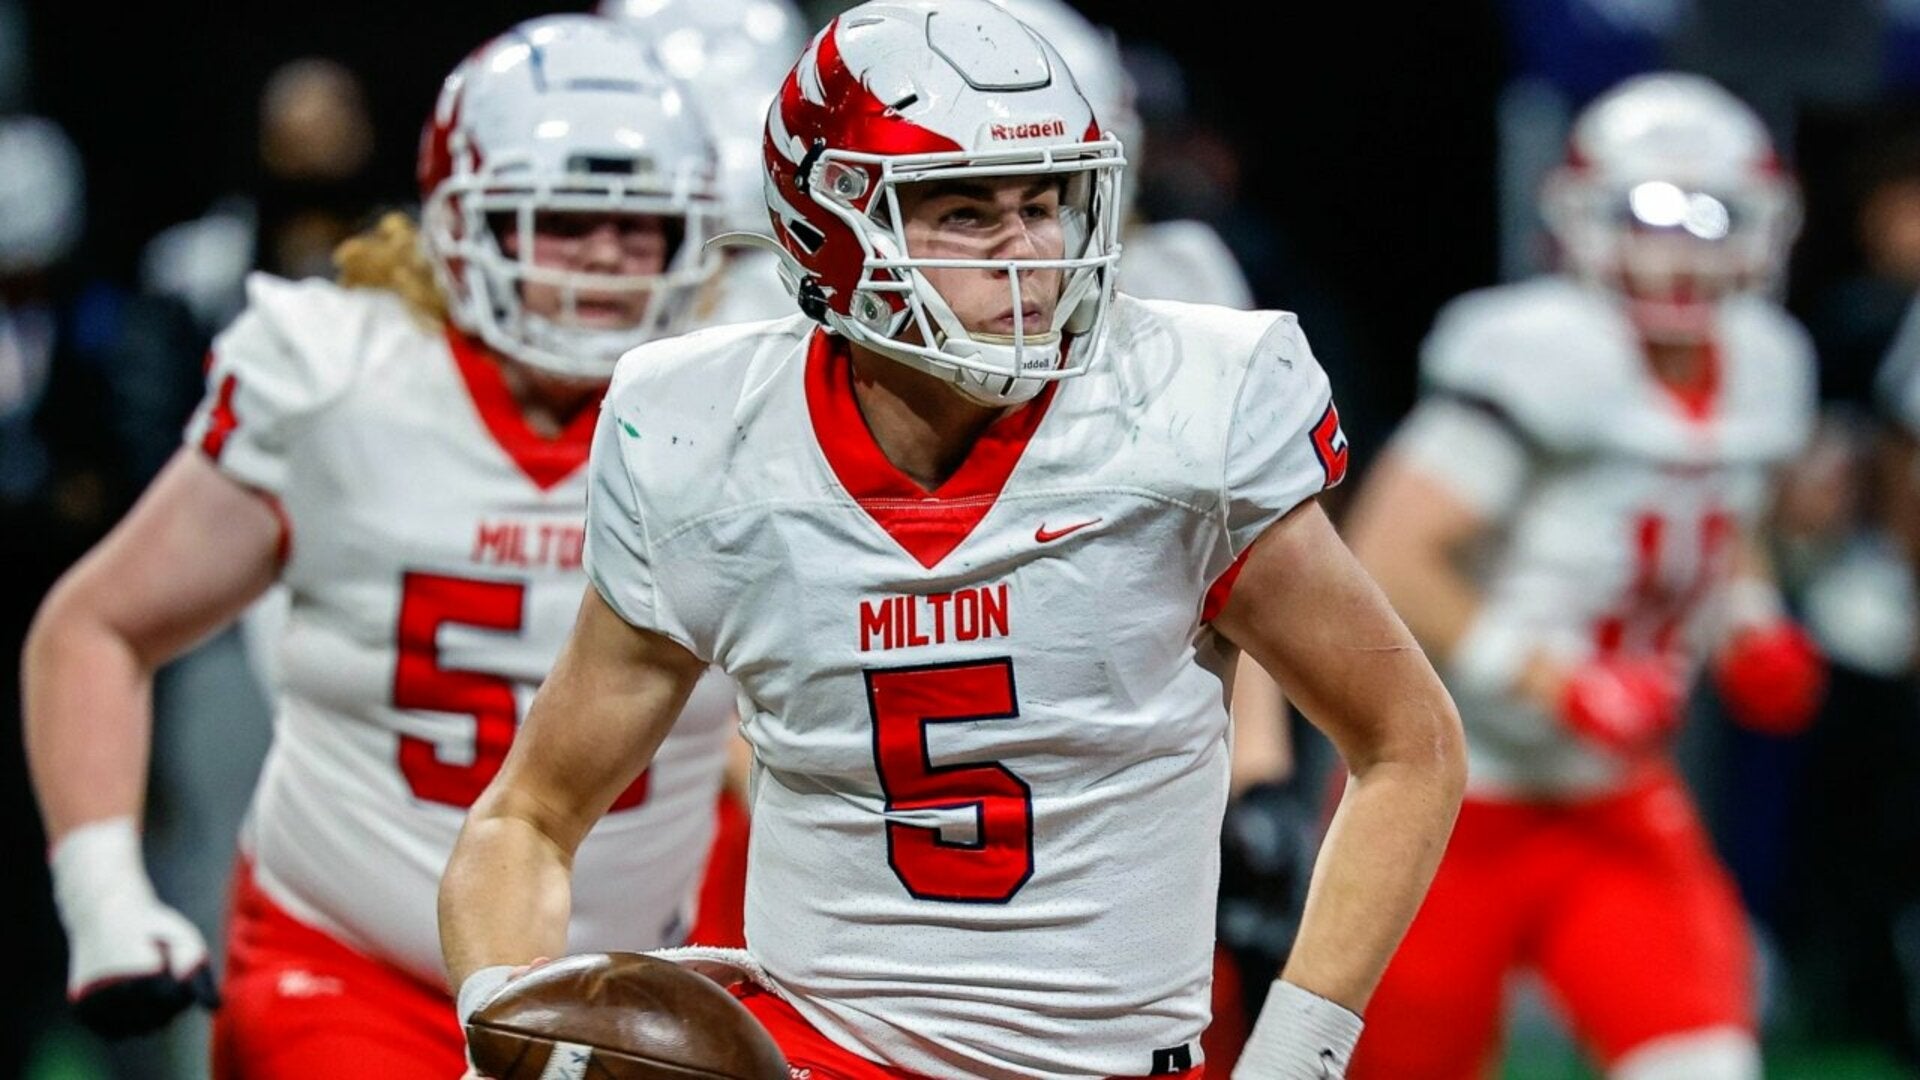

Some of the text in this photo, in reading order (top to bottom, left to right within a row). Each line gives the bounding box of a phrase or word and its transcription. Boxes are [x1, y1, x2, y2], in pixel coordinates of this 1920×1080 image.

[470, 520, 586, 570] MILTO
[860, 584, 1009, 651] MILTON
[862, 655, 1035, 904] 5
[1168, 1054, 1180, 1073] L
